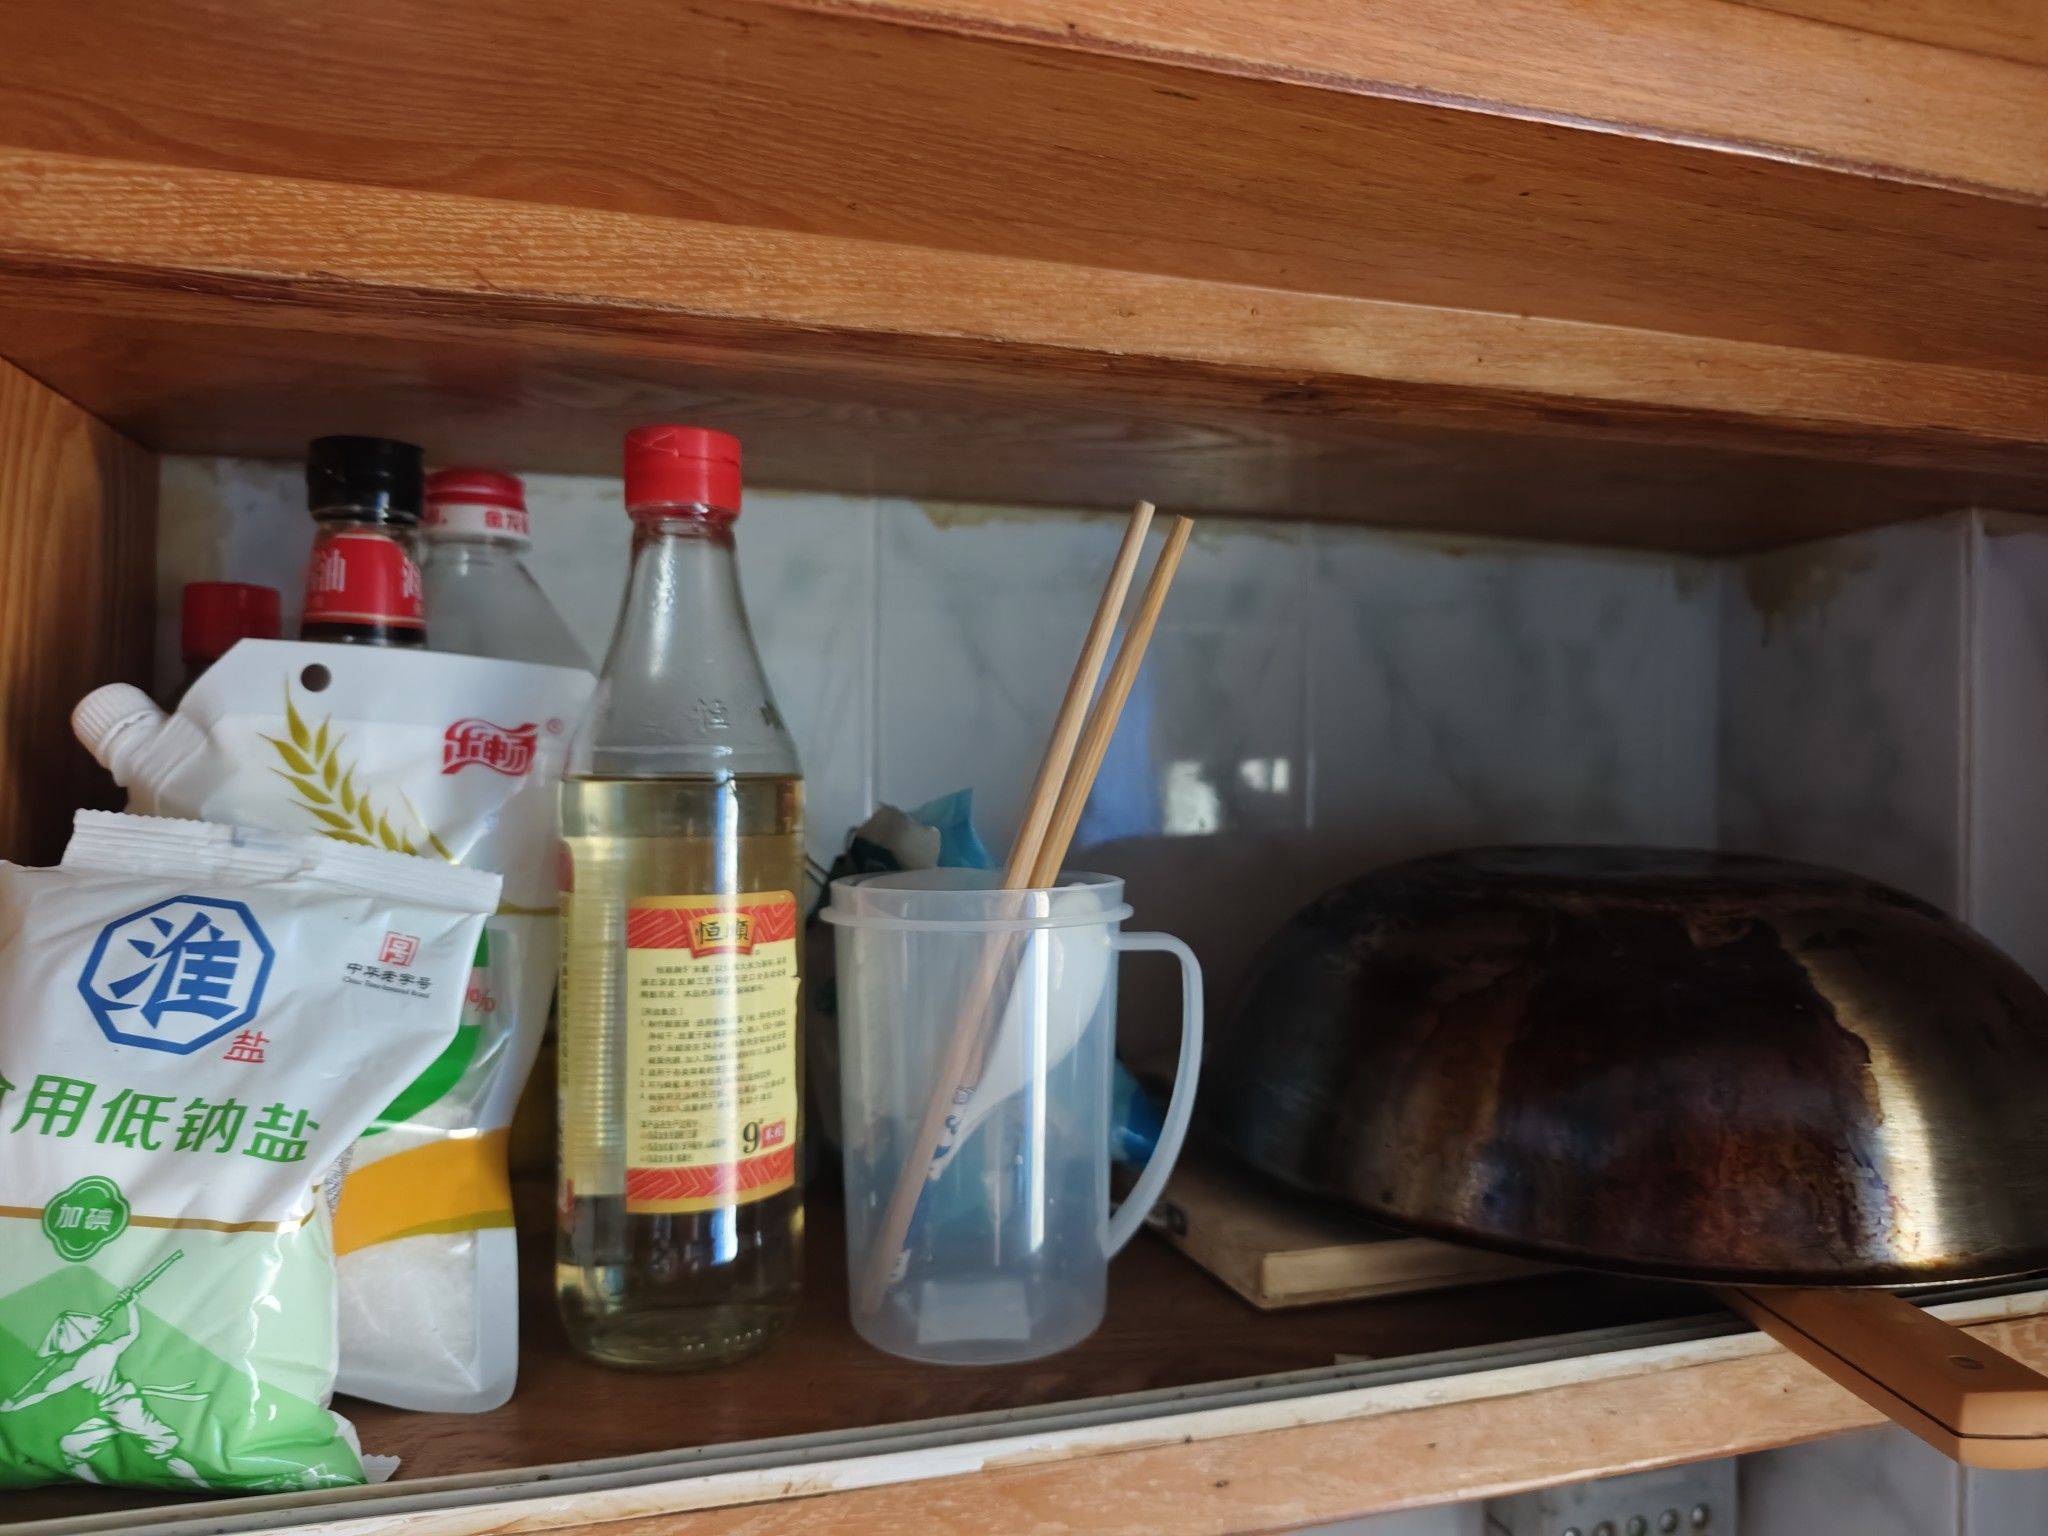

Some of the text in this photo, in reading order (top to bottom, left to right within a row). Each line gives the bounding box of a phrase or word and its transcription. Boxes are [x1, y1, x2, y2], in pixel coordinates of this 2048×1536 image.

[98, 911, 242, 1029] 淮
[223, 1030, 270, 1064] 盐
[56, 1203, 114, 1232] 加碘
